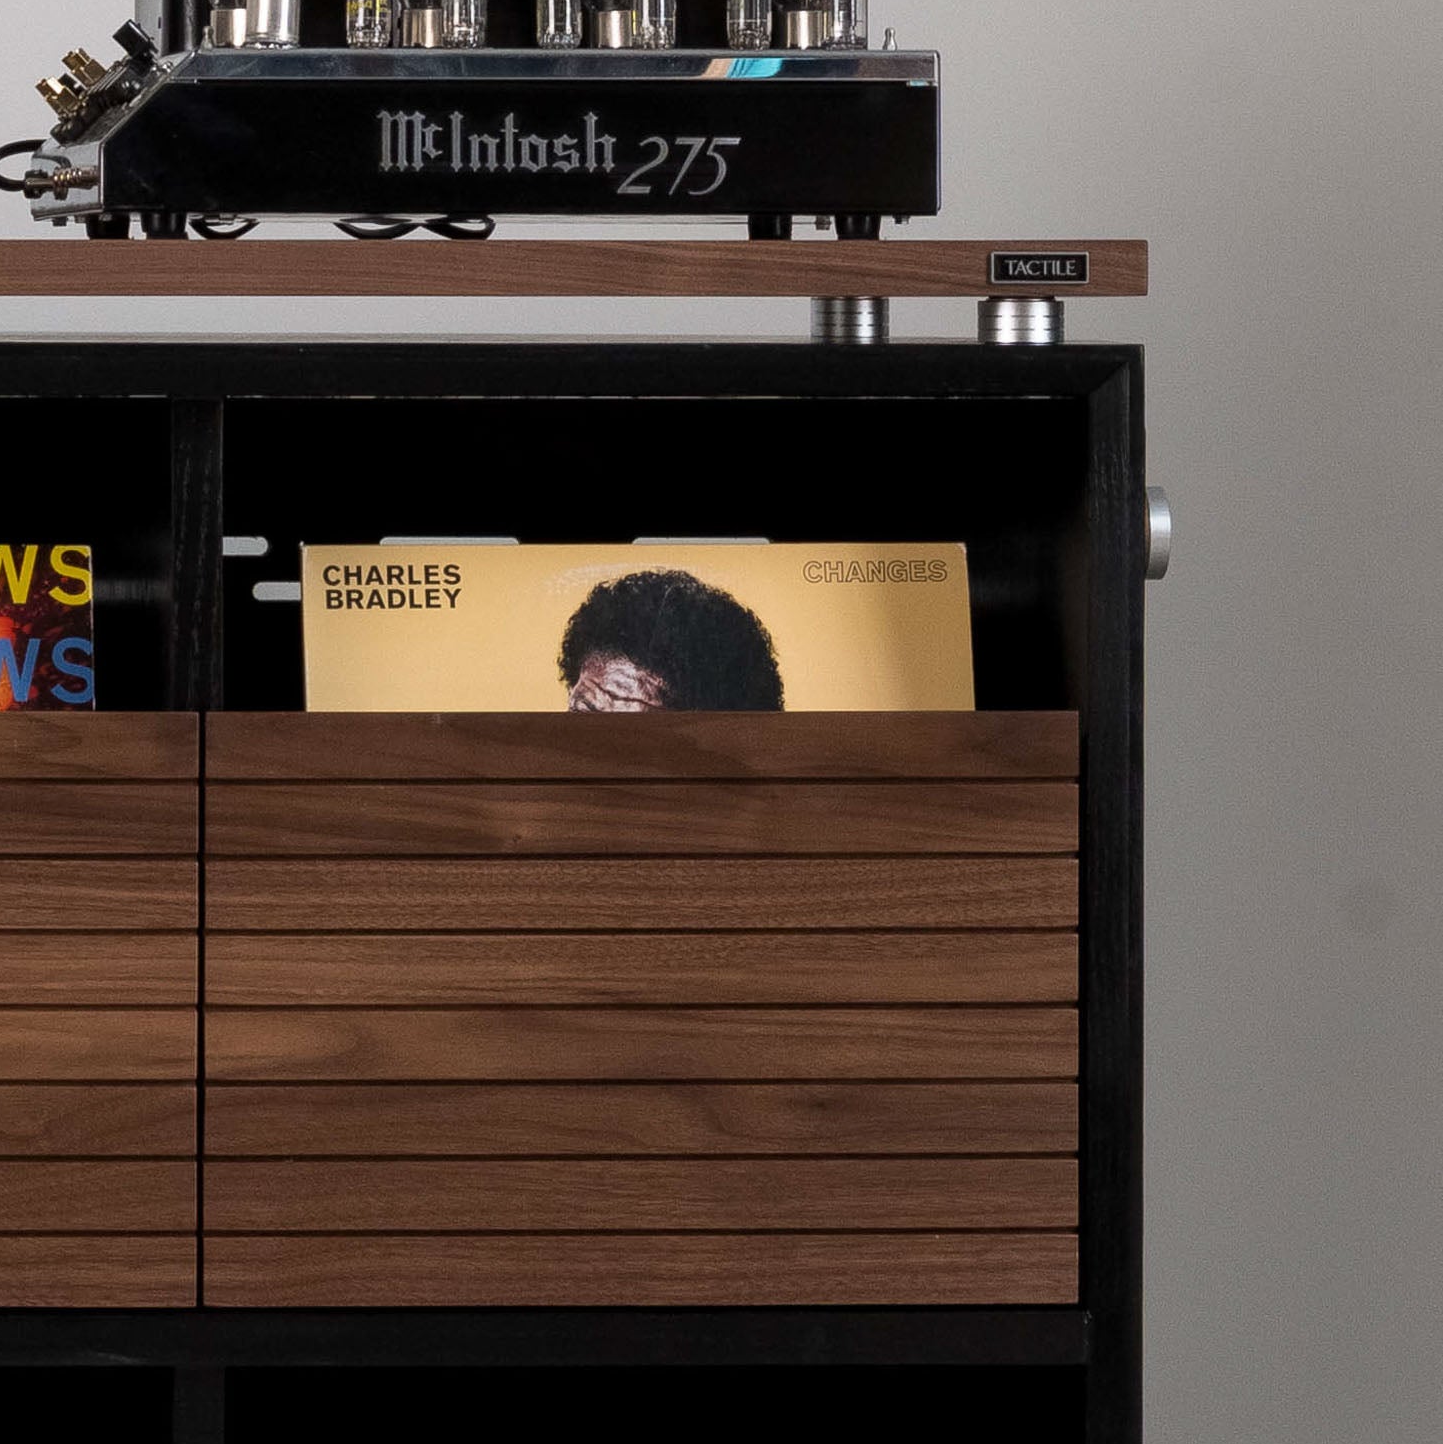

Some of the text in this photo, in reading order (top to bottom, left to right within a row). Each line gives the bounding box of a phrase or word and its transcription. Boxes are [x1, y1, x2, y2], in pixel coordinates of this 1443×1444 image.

[376, 110, 743, 196] McIntosh 275
[1004, 259, 1077, 276] TACTILE
[322, 564, 462, 586] CHARLES
[803, 559, 948, 584] CHANGES
[325, 588, 462, 609] BRADLEY
